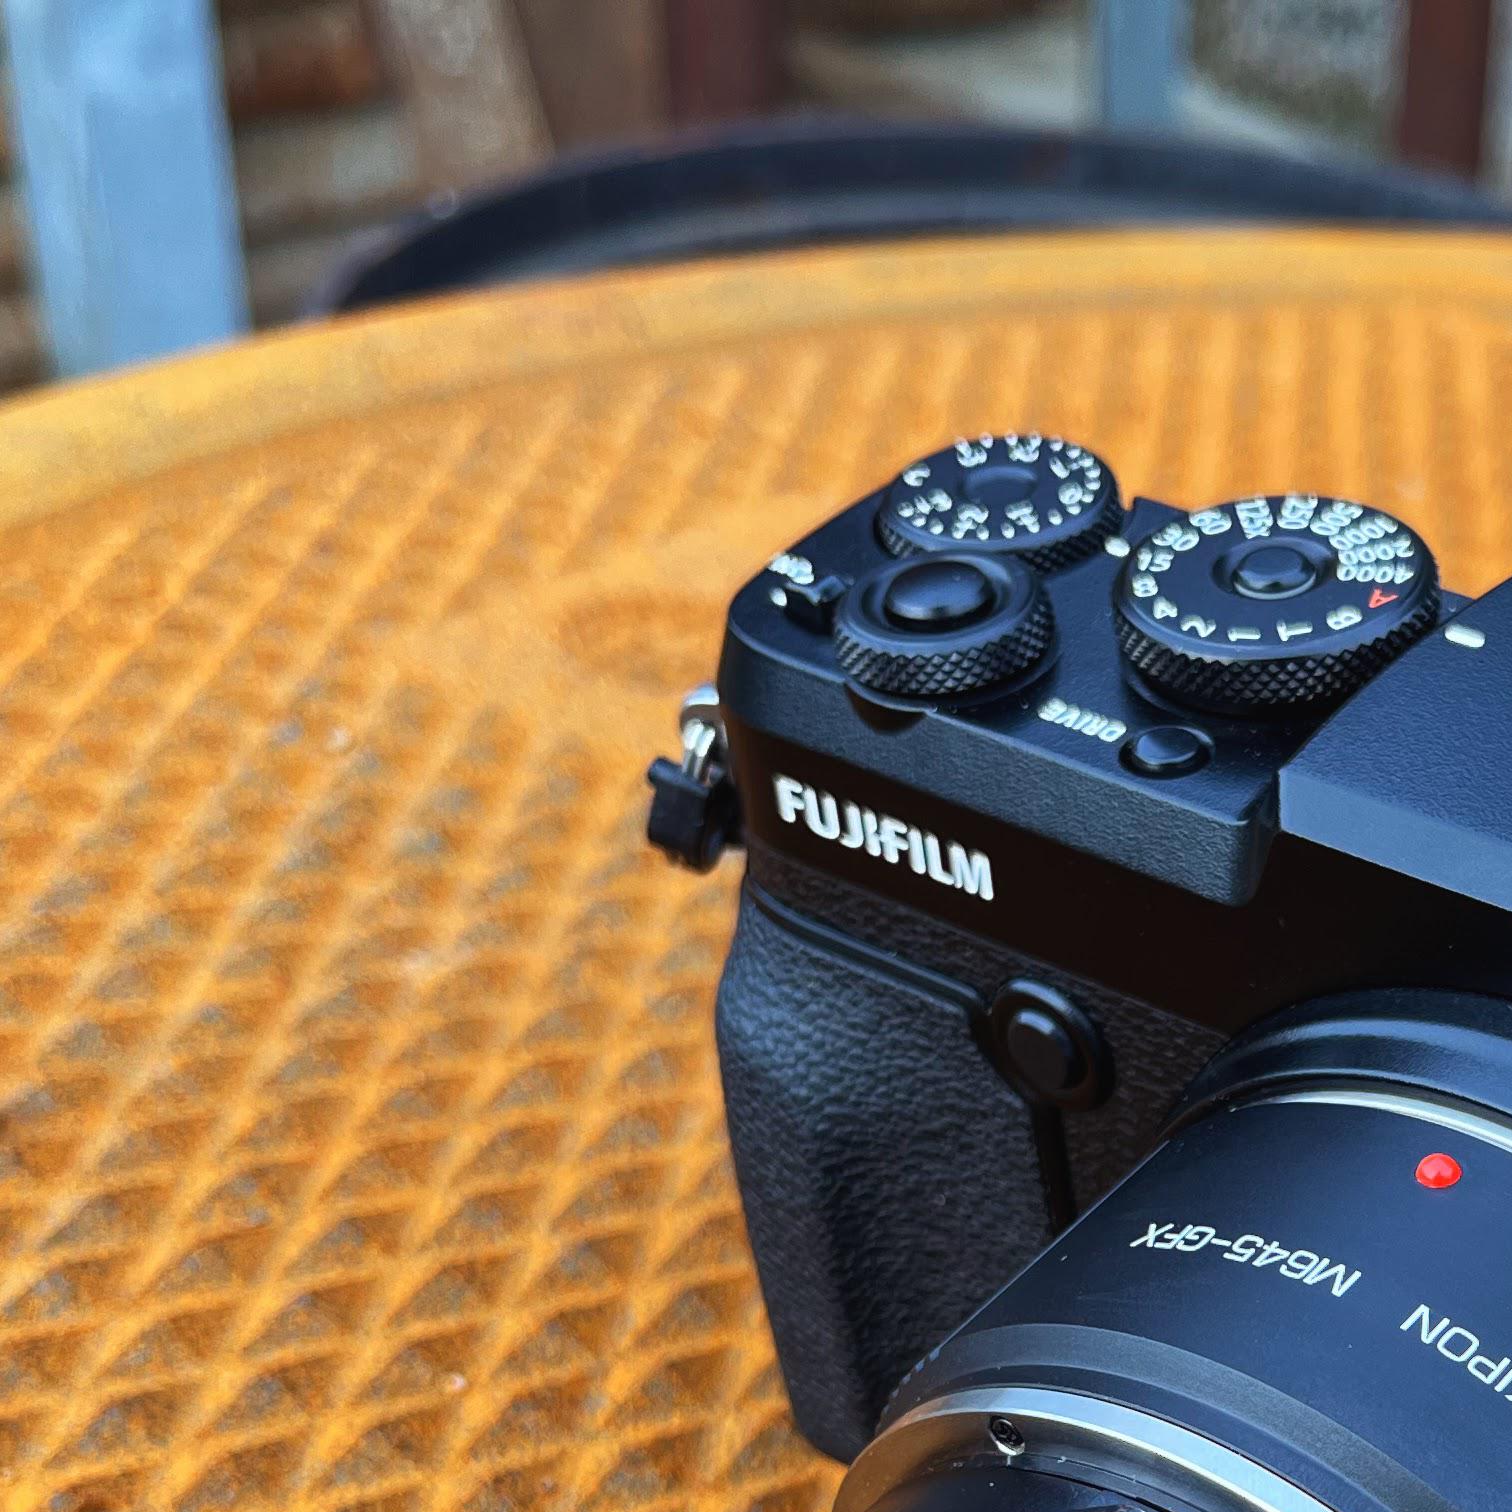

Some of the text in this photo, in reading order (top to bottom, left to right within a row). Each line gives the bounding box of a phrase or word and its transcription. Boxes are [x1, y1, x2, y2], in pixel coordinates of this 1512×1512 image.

[1337, 532, 1414, 565] 2000
[1336, 562, 1414, 584] 4000
[1368, 588, 1399, 609] A
[1180, 614, 1216, 638] 2
[1276, 619, 1313, 642] T
[1326, 605, 1363, 631] B
[1037, 698, 1127, 742] DRIVE
[773, 773, 994, 900] FUJIFILM
[1129, 1222, 1362, 1298] M645-GFX
